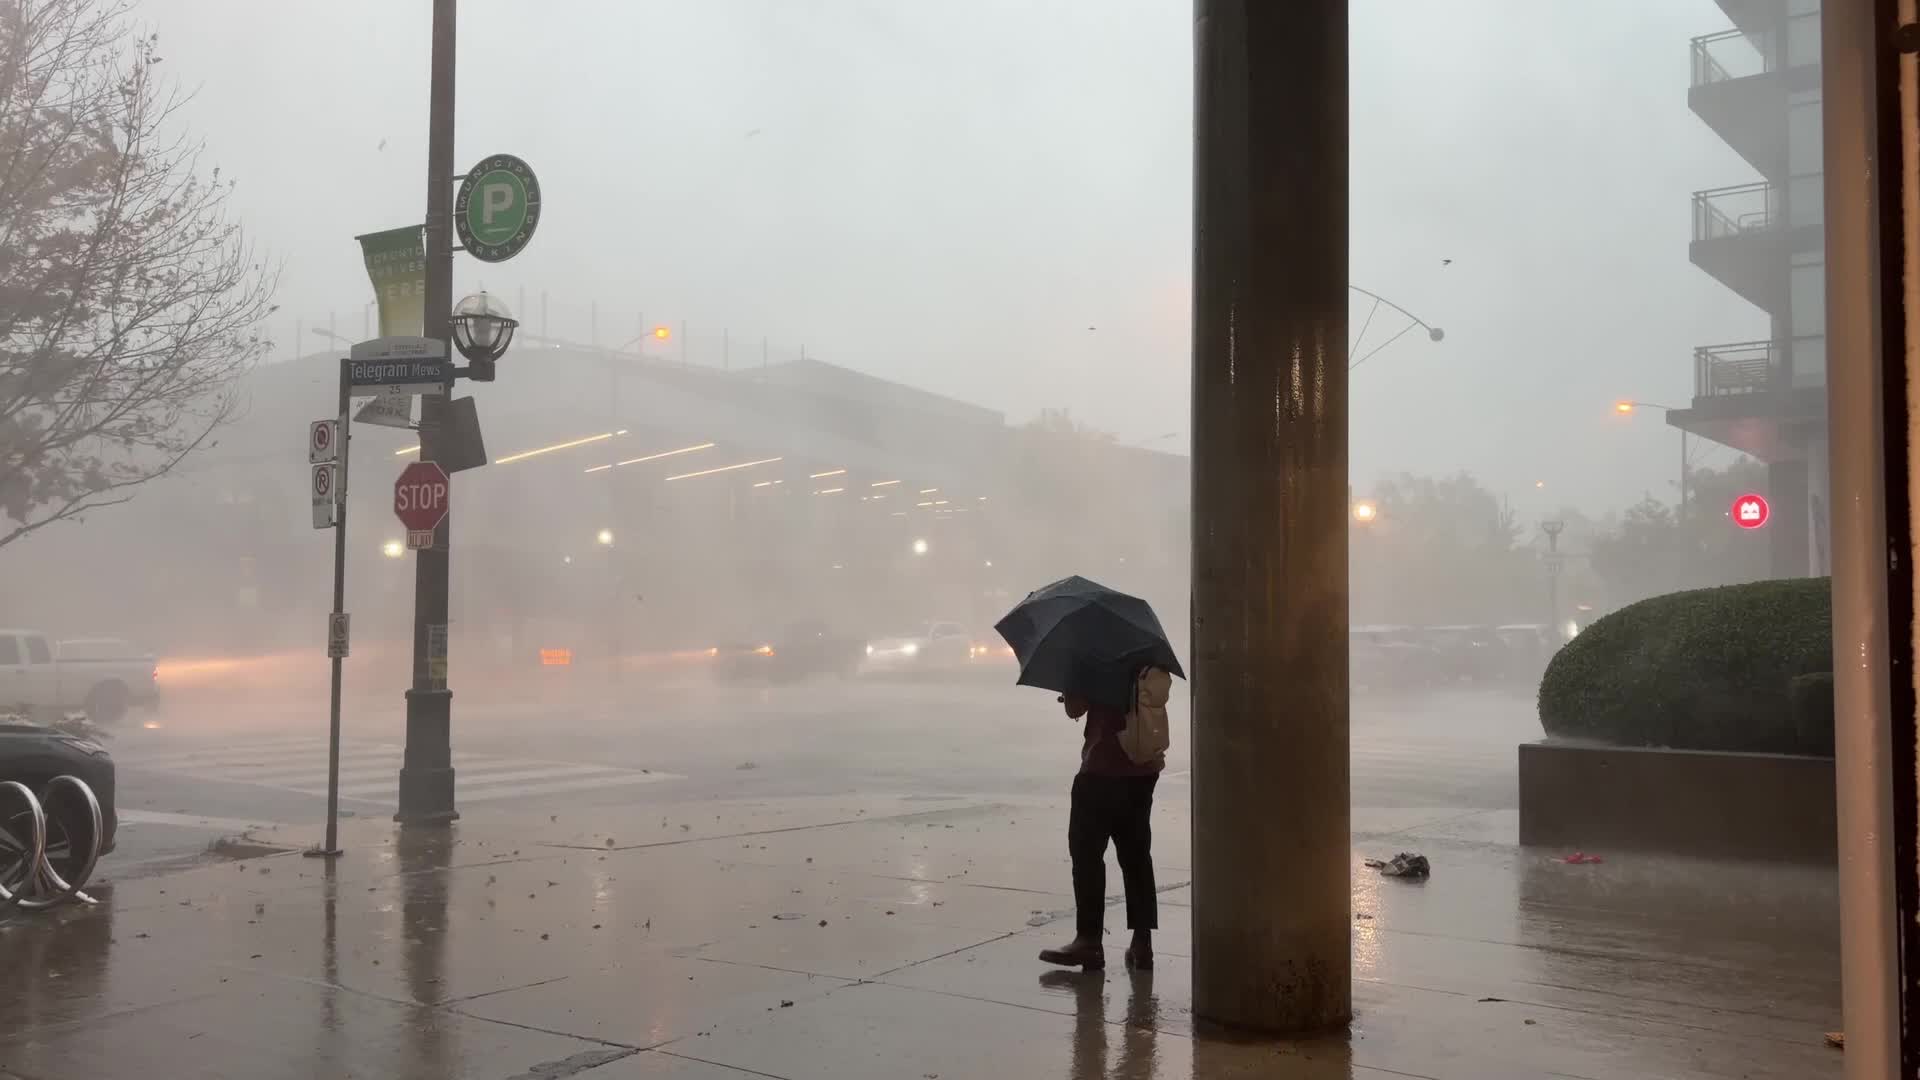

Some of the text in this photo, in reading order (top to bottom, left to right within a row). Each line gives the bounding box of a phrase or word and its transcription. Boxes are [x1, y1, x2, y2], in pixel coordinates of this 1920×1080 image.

[460, 159, 535, 208] MUNICIPAL
[482, 183, 514, 224] P
[459, 215, 534, 257] PARKING
[351, 362, 440, 382] Telegram Mews
[398, 483, 446, 511] STOP
